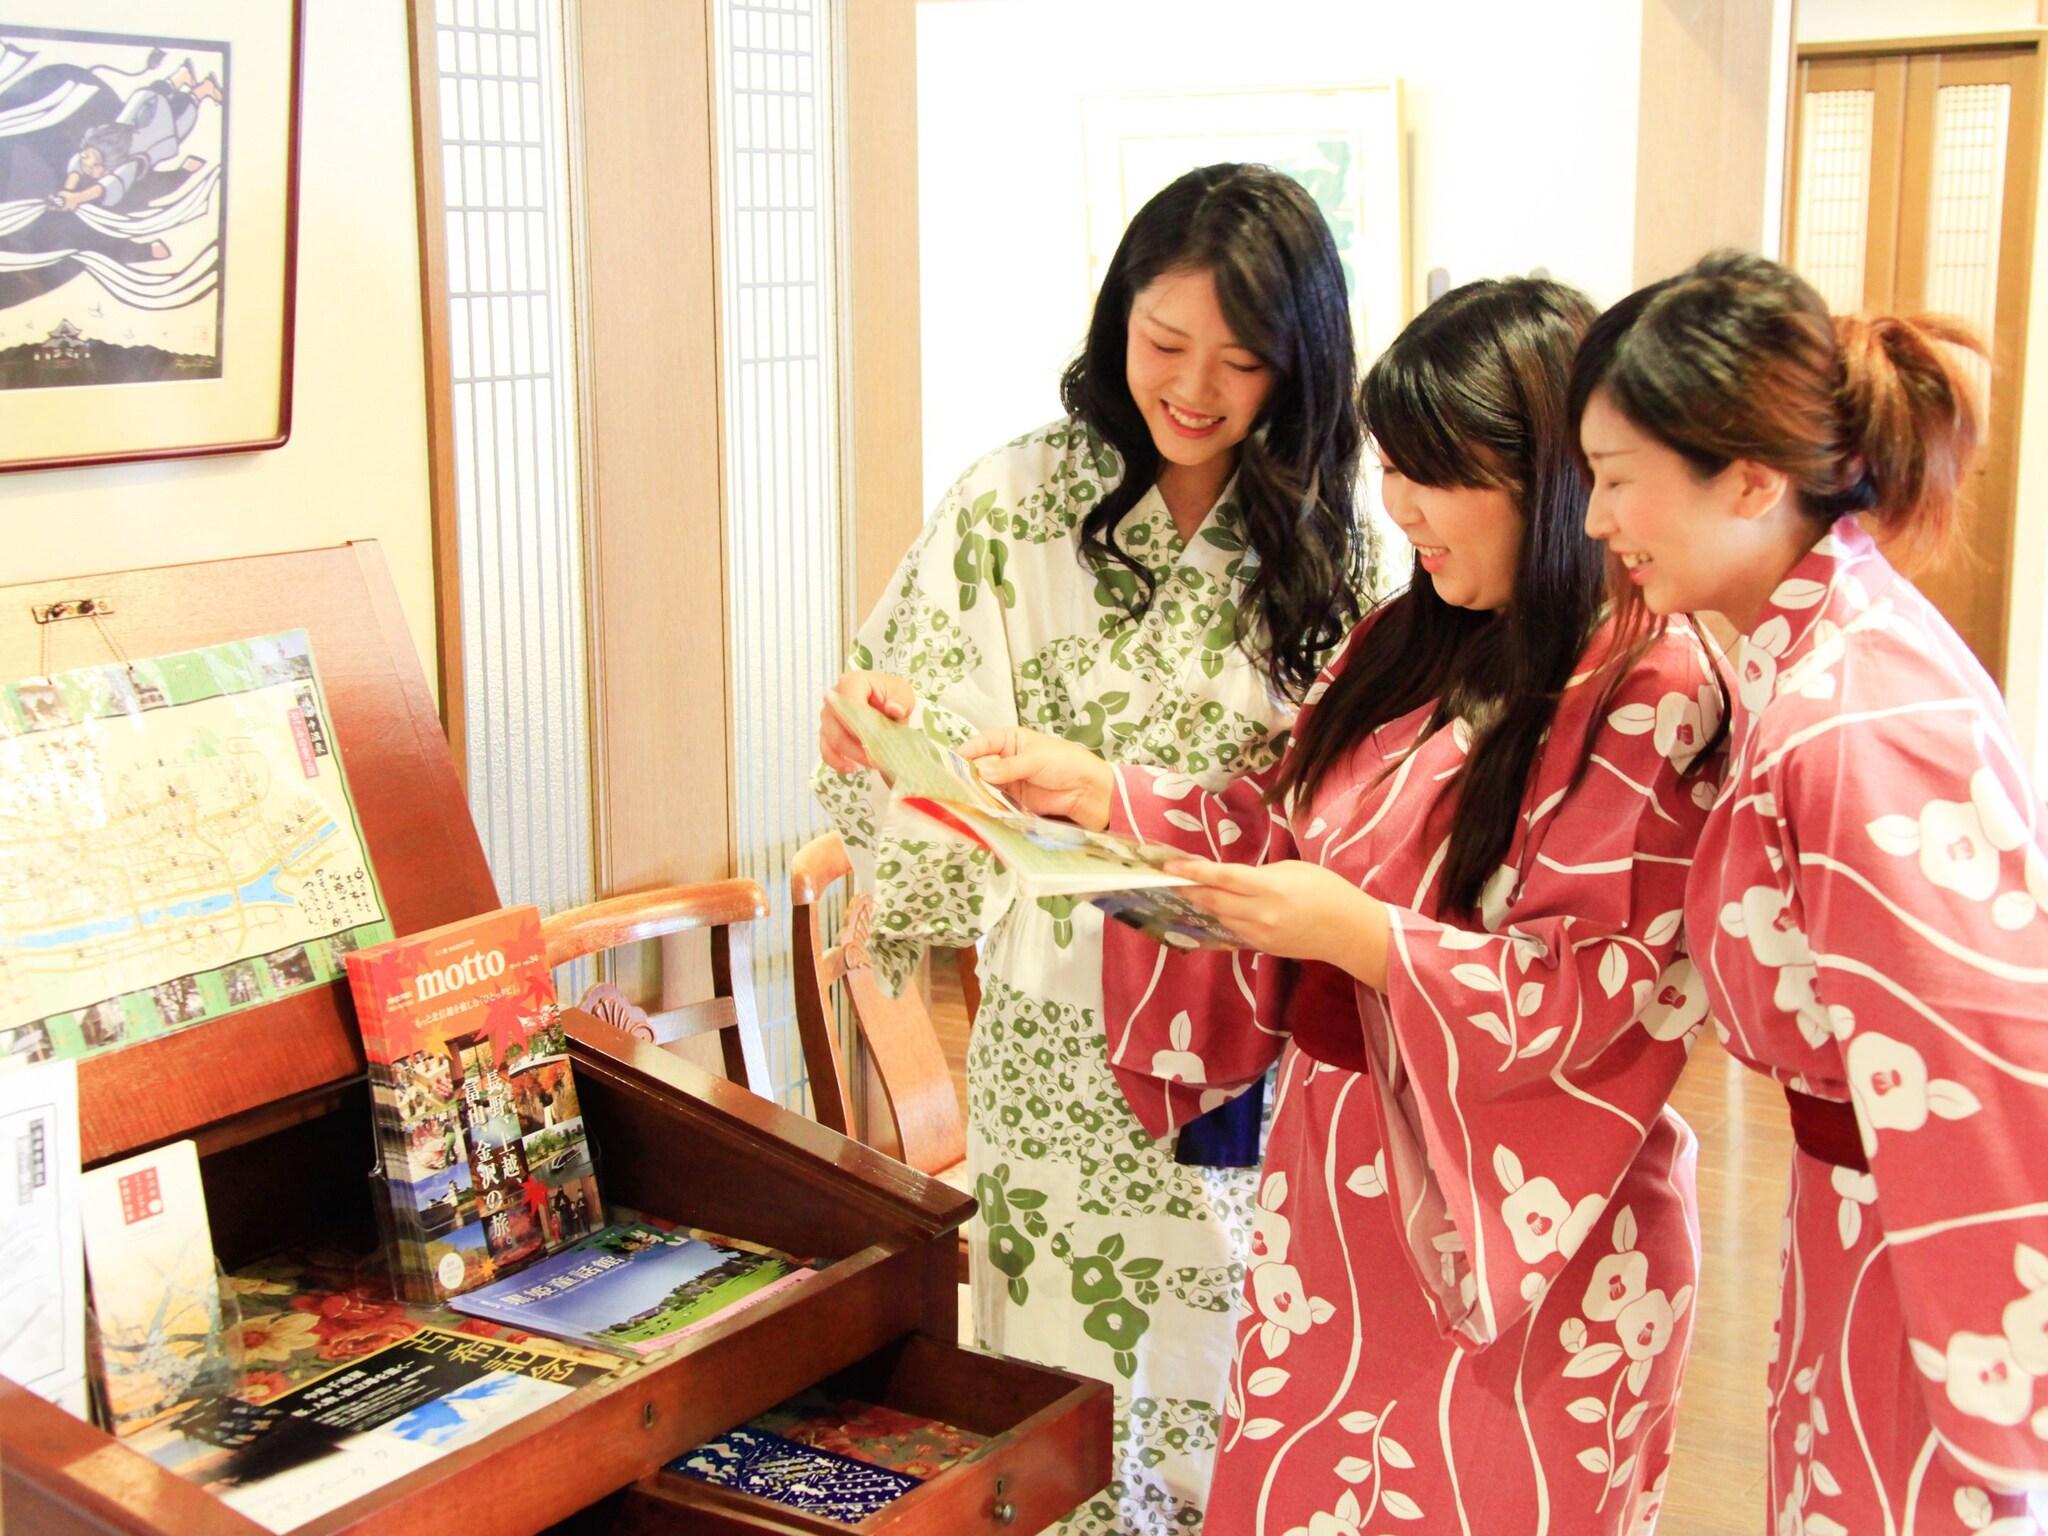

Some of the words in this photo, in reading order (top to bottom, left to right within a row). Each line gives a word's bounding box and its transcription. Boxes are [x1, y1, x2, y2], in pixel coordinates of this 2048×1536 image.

[415, 949, 506, 1002] motto
[402, 1330, 578, 1382] 古希記念
